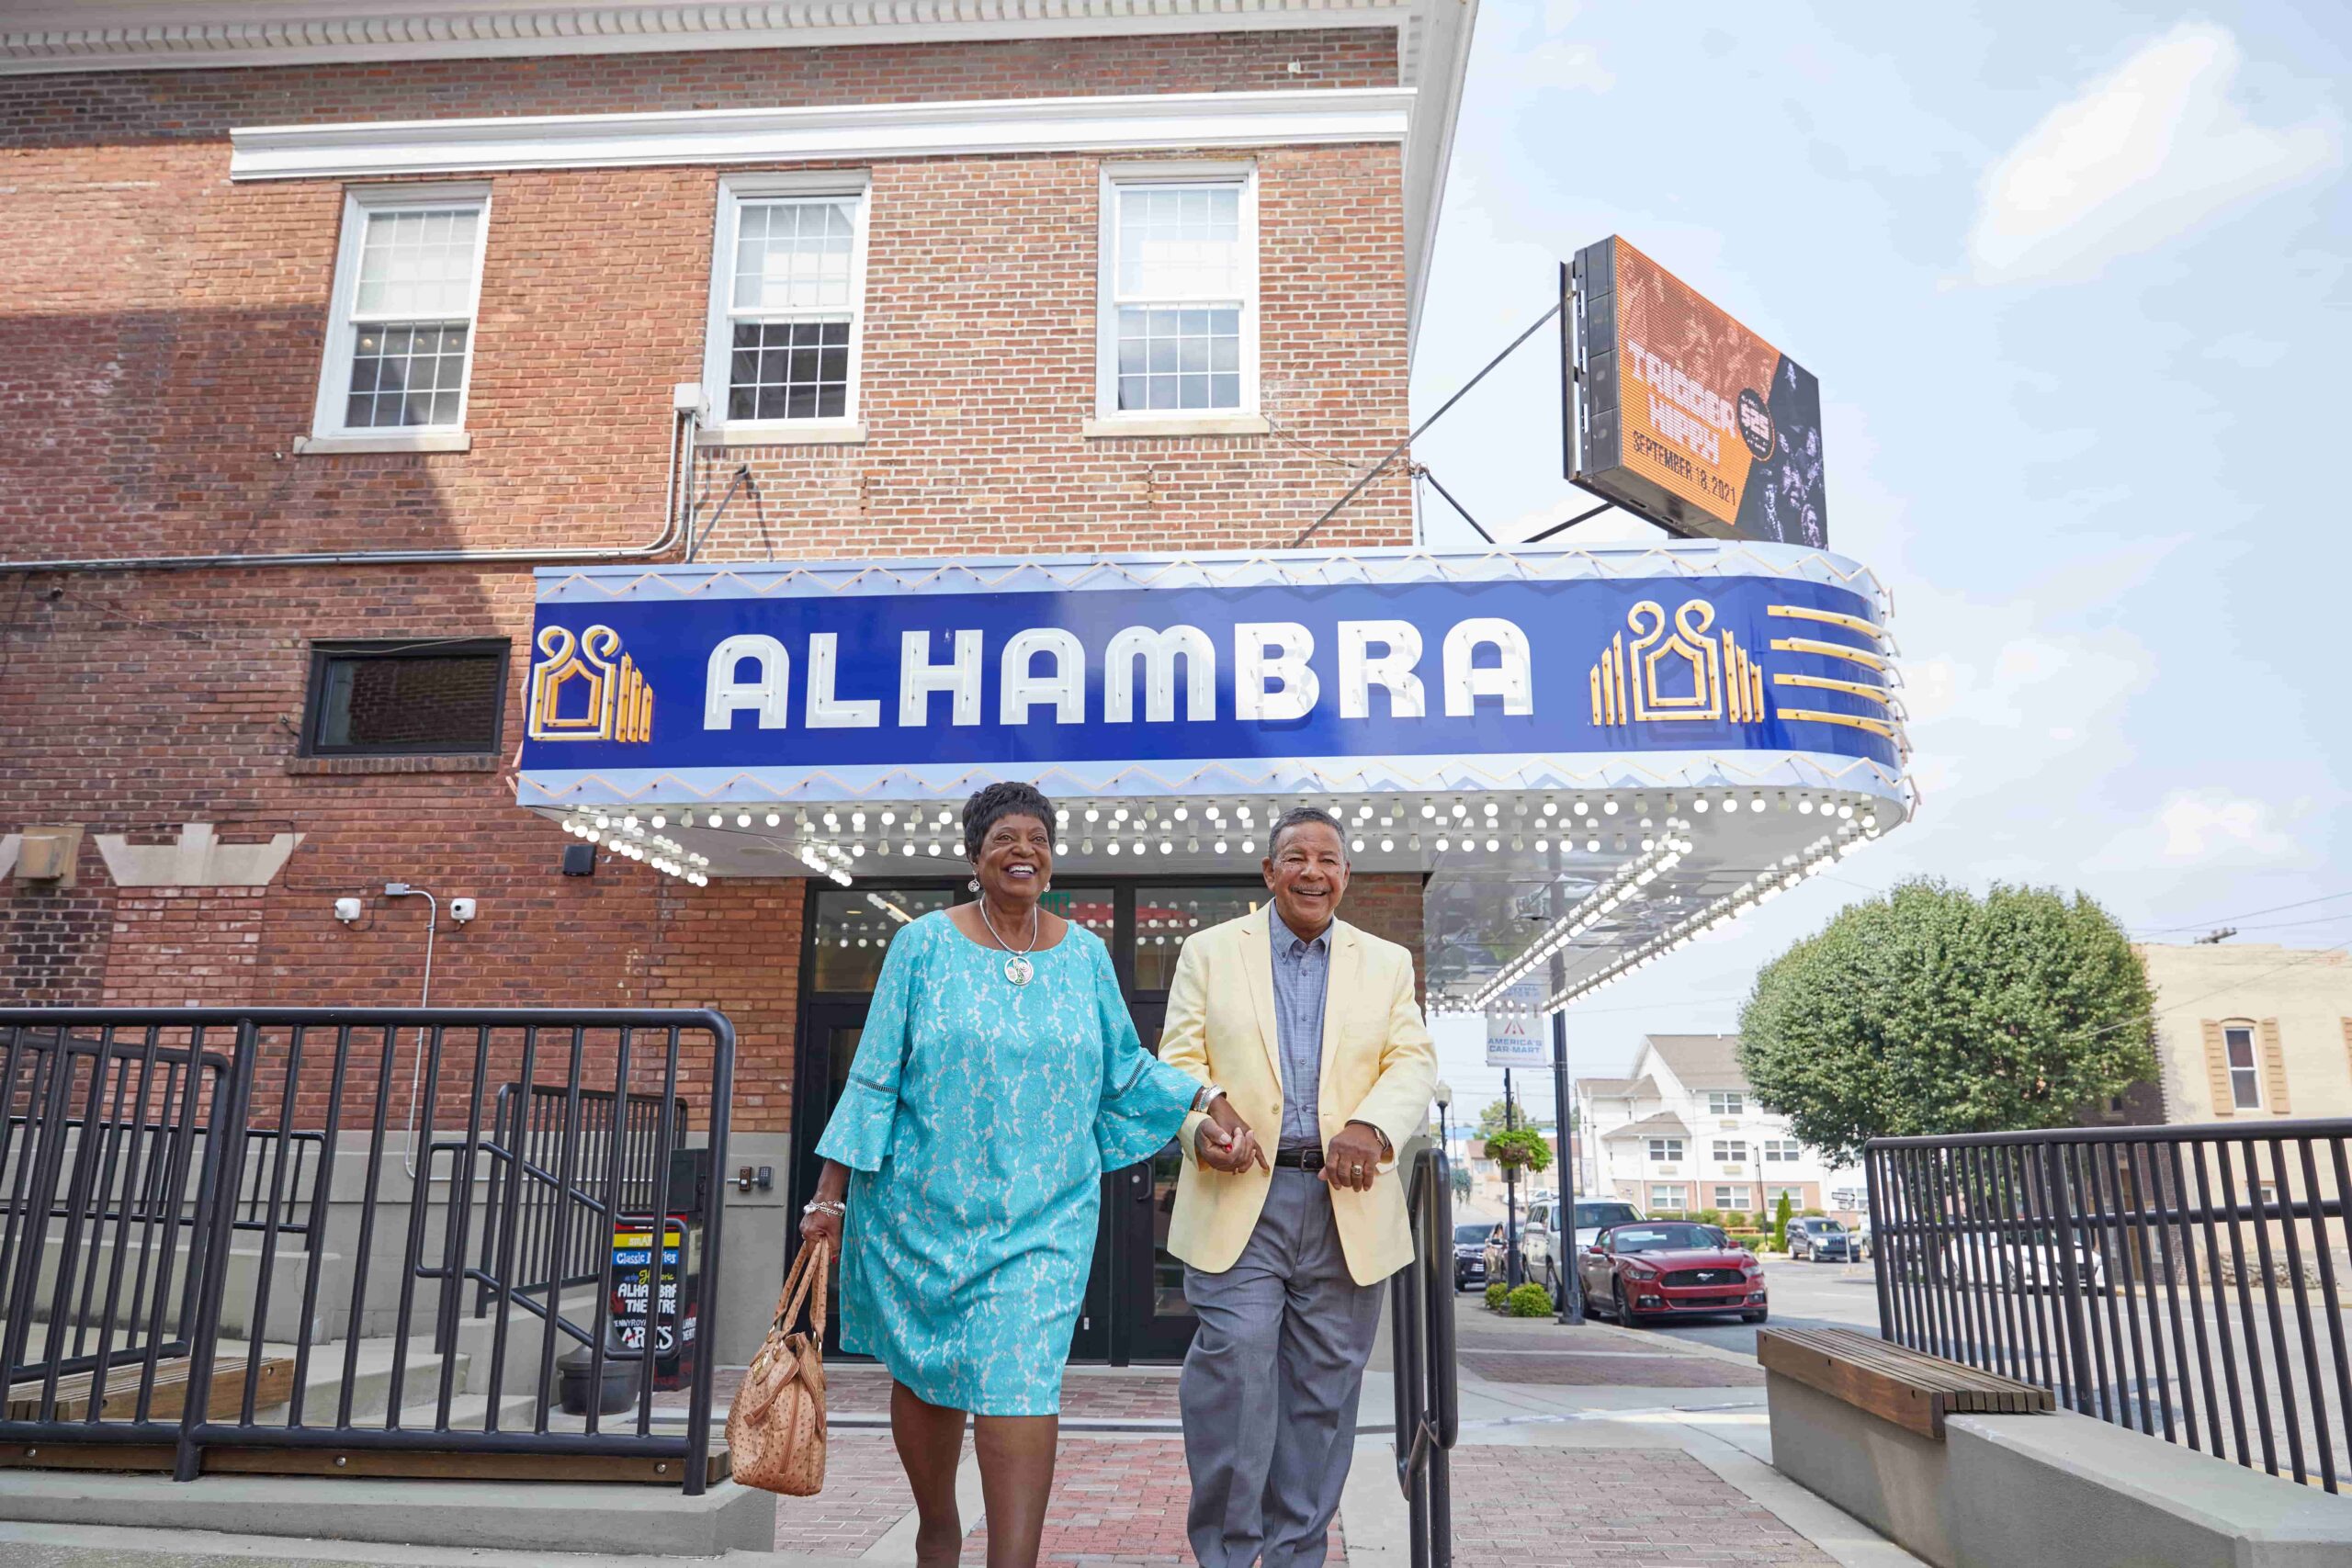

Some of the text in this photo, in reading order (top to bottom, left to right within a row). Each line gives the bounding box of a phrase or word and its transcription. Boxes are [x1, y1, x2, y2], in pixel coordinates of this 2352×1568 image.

[1627, 339, 1736, 438] TRIGGER
[1633, 431, 1692, 481] SEPTEMBER
[1712, 476, 1736, 505] 2021
[704, 617, 1533, 730] ALHAMBRA
[1488, 1038, 1543, 1047] AMERICA'S
[616, 1253, 645, 1264] Classic
[625, 1299, 676, 1314] THETRE
[622, 1325, 673, 1350] ARS
